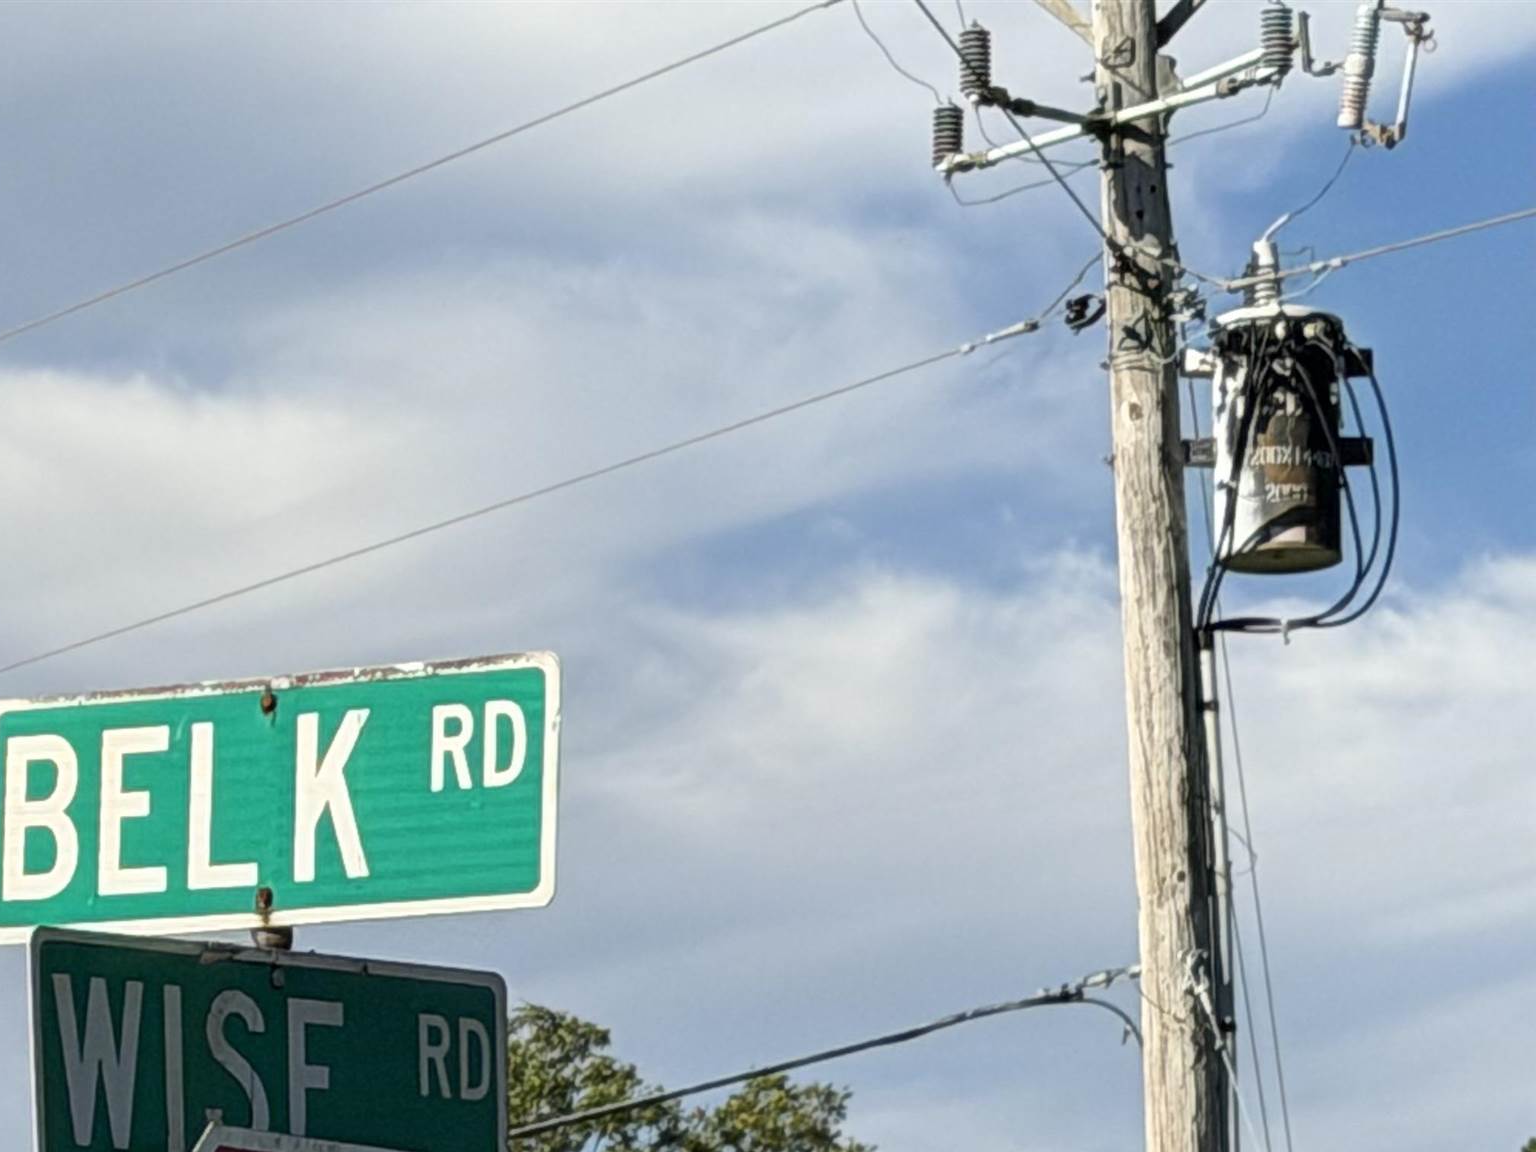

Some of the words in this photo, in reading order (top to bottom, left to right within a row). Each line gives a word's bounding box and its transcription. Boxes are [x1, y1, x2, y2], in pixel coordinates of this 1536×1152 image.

[1, 708, 370, 901] BELK
[429, 699, 528, 792] RD
[418, 1012, 491, 1102] RD
